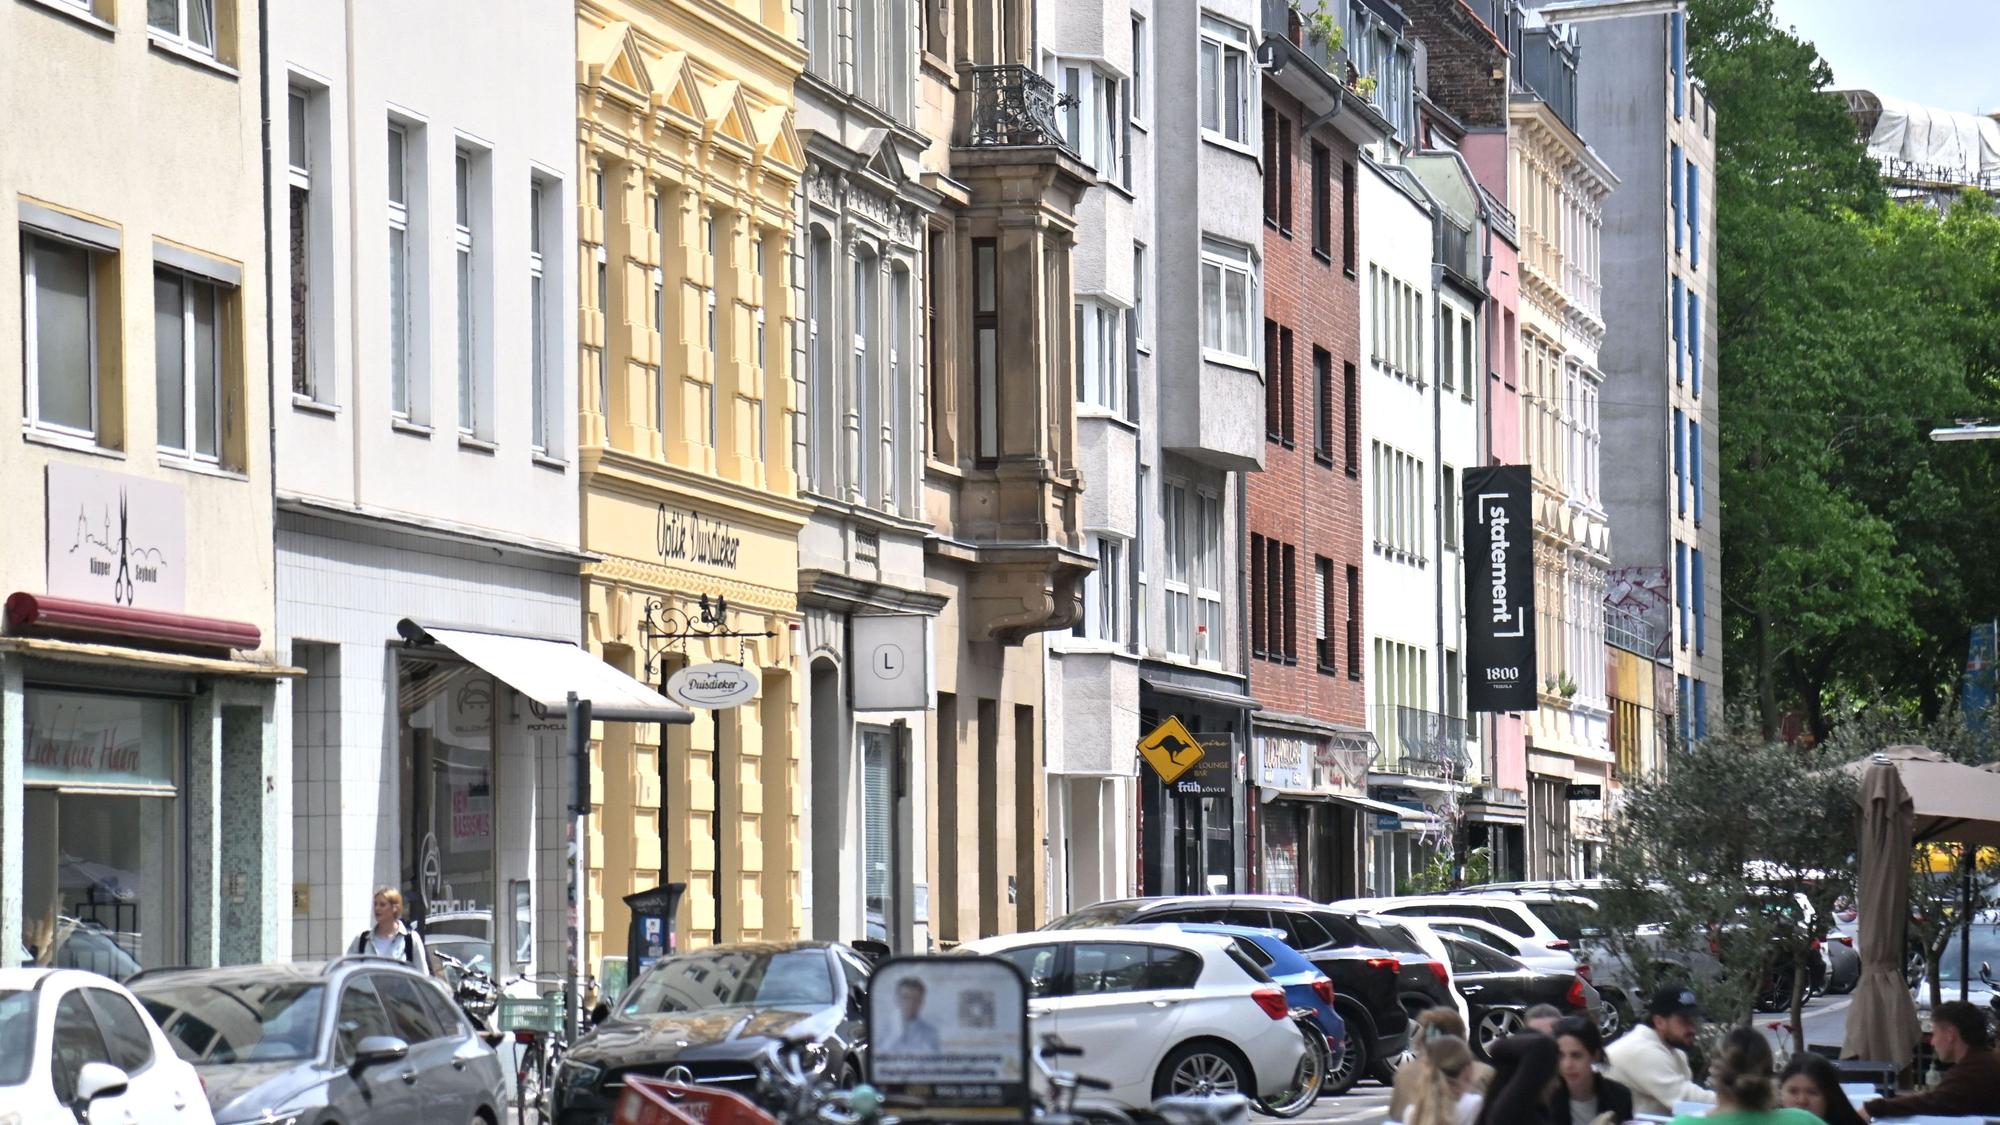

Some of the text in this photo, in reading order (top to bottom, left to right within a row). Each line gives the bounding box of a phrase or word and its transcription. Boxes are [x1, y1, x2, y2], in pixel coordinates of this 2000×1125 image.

[657, 503, 740, 570] Optik Duisdieker
[1490, 506, 1512, 622] statement
[885, 653, 894, 669] L
[1486, 666, 1519, 681] 1800
[688, 678, 738, 690] Duisdieker
[99, 725, 139, 771] Haare
[1177, 780, 1201, 793] früh
